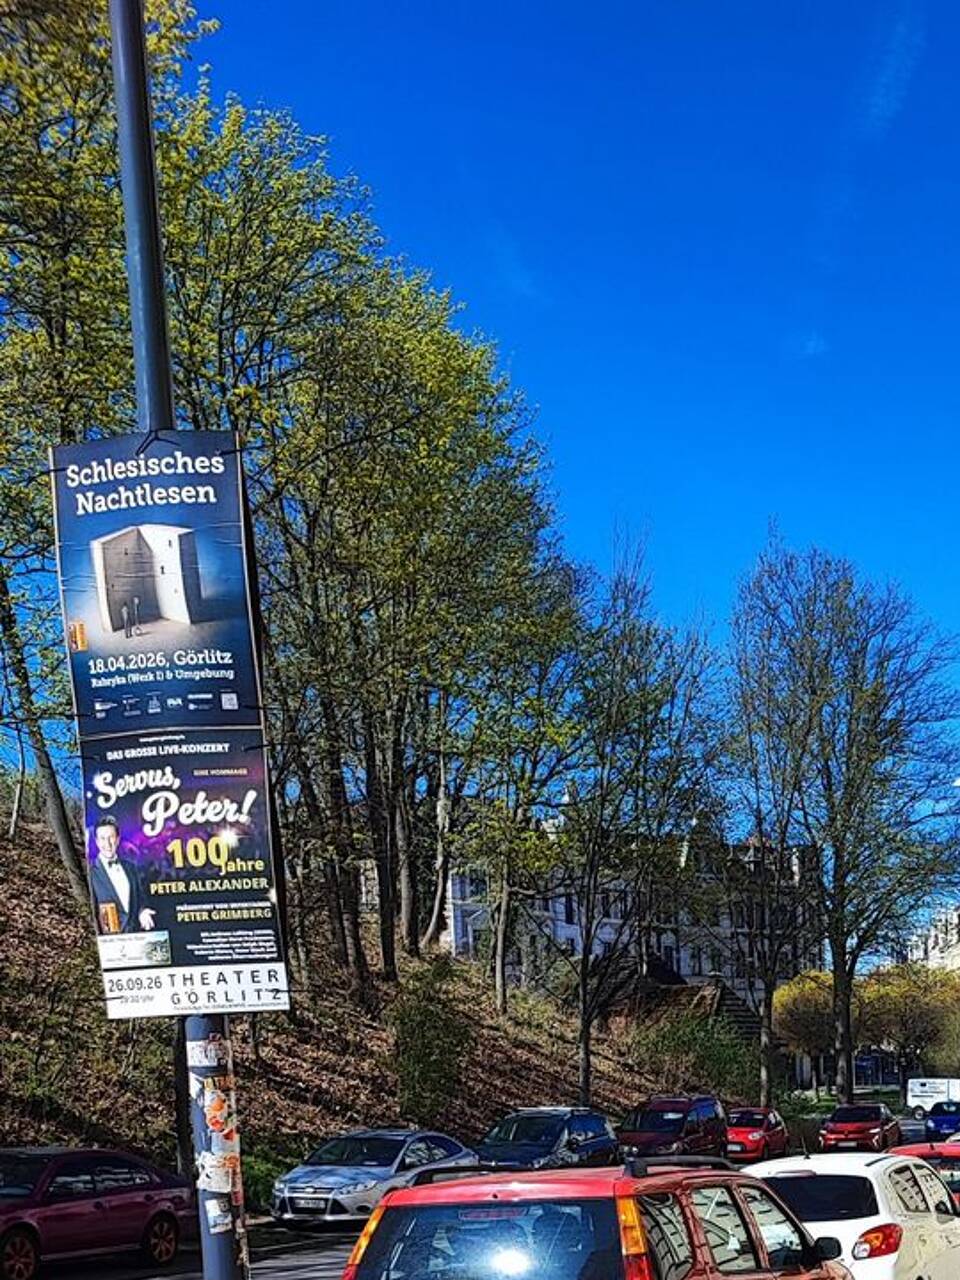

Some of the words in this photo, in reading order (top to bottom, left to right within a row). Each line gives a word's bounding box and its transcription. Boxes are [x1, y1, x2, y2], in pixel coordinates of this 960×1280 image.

[66, 450, 225, 488] Schlesisches
[75, 483, 217, 516] Nachtlesen
[88, 652, 170, 674] 18.04.2026,
[173, 649, 233, 666] Görlitz
[175, 668, 235, 680] Umgebung
[106, 751, 124, 761] DAS
[124, 747, 158, 759] GROSSE
[159, 743, 230, 755] LIVE-KONZERT
[94, 766, 180, 808] Servus,
[142, 790, 257, 837] Peter!
[166, 836, 229, 868] 100
[219, 858, 265, 876] Jahre
[150, 881, 186, 895] PETER
[189, 877, 269, 891] ALEXANDER
[176, 911, 209, 922] PETER
[211, 908, 272, 920] GRIMBERG
[108, 976, 163, 993] 26.09.26
[168, 969, 279, 988] THEATER
